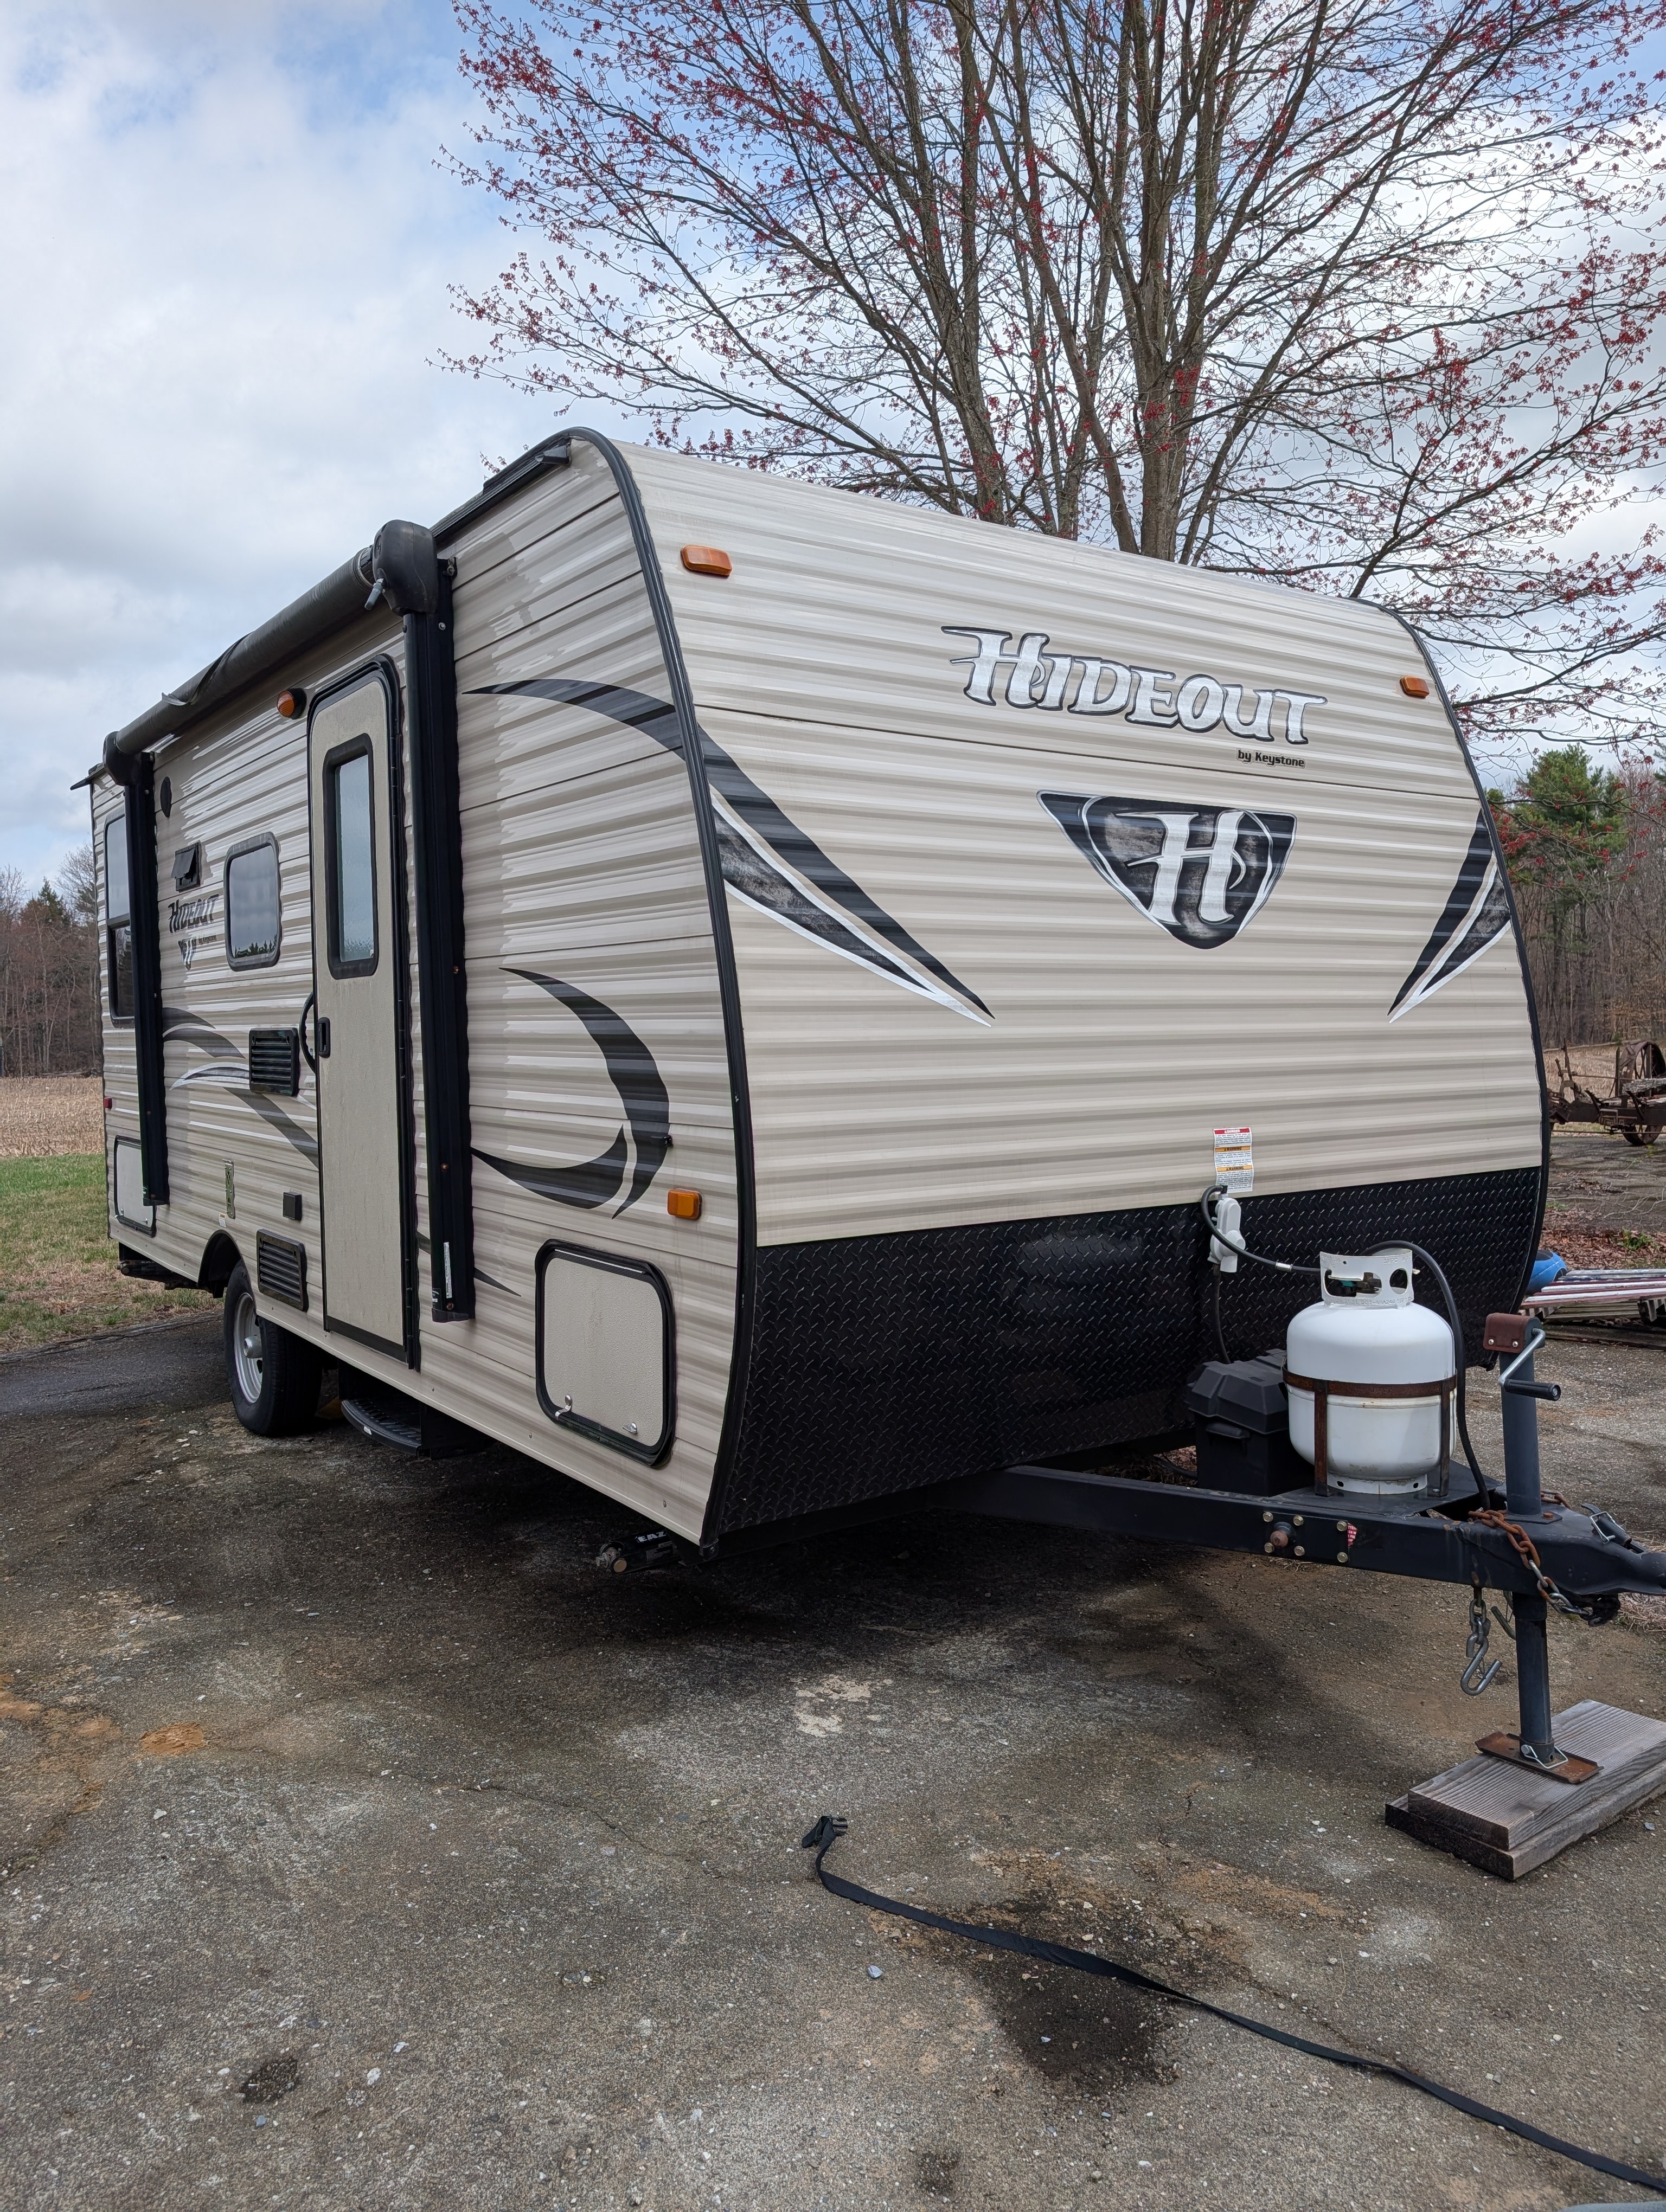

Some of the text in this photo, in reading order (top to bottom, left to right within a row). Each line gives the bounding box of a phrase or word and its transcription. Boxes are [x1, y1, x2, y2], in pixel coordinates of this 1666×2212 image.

[940, 626, 1328, 745] HIDEOUT
[1238, 749, 1305, 767] by Keystone
